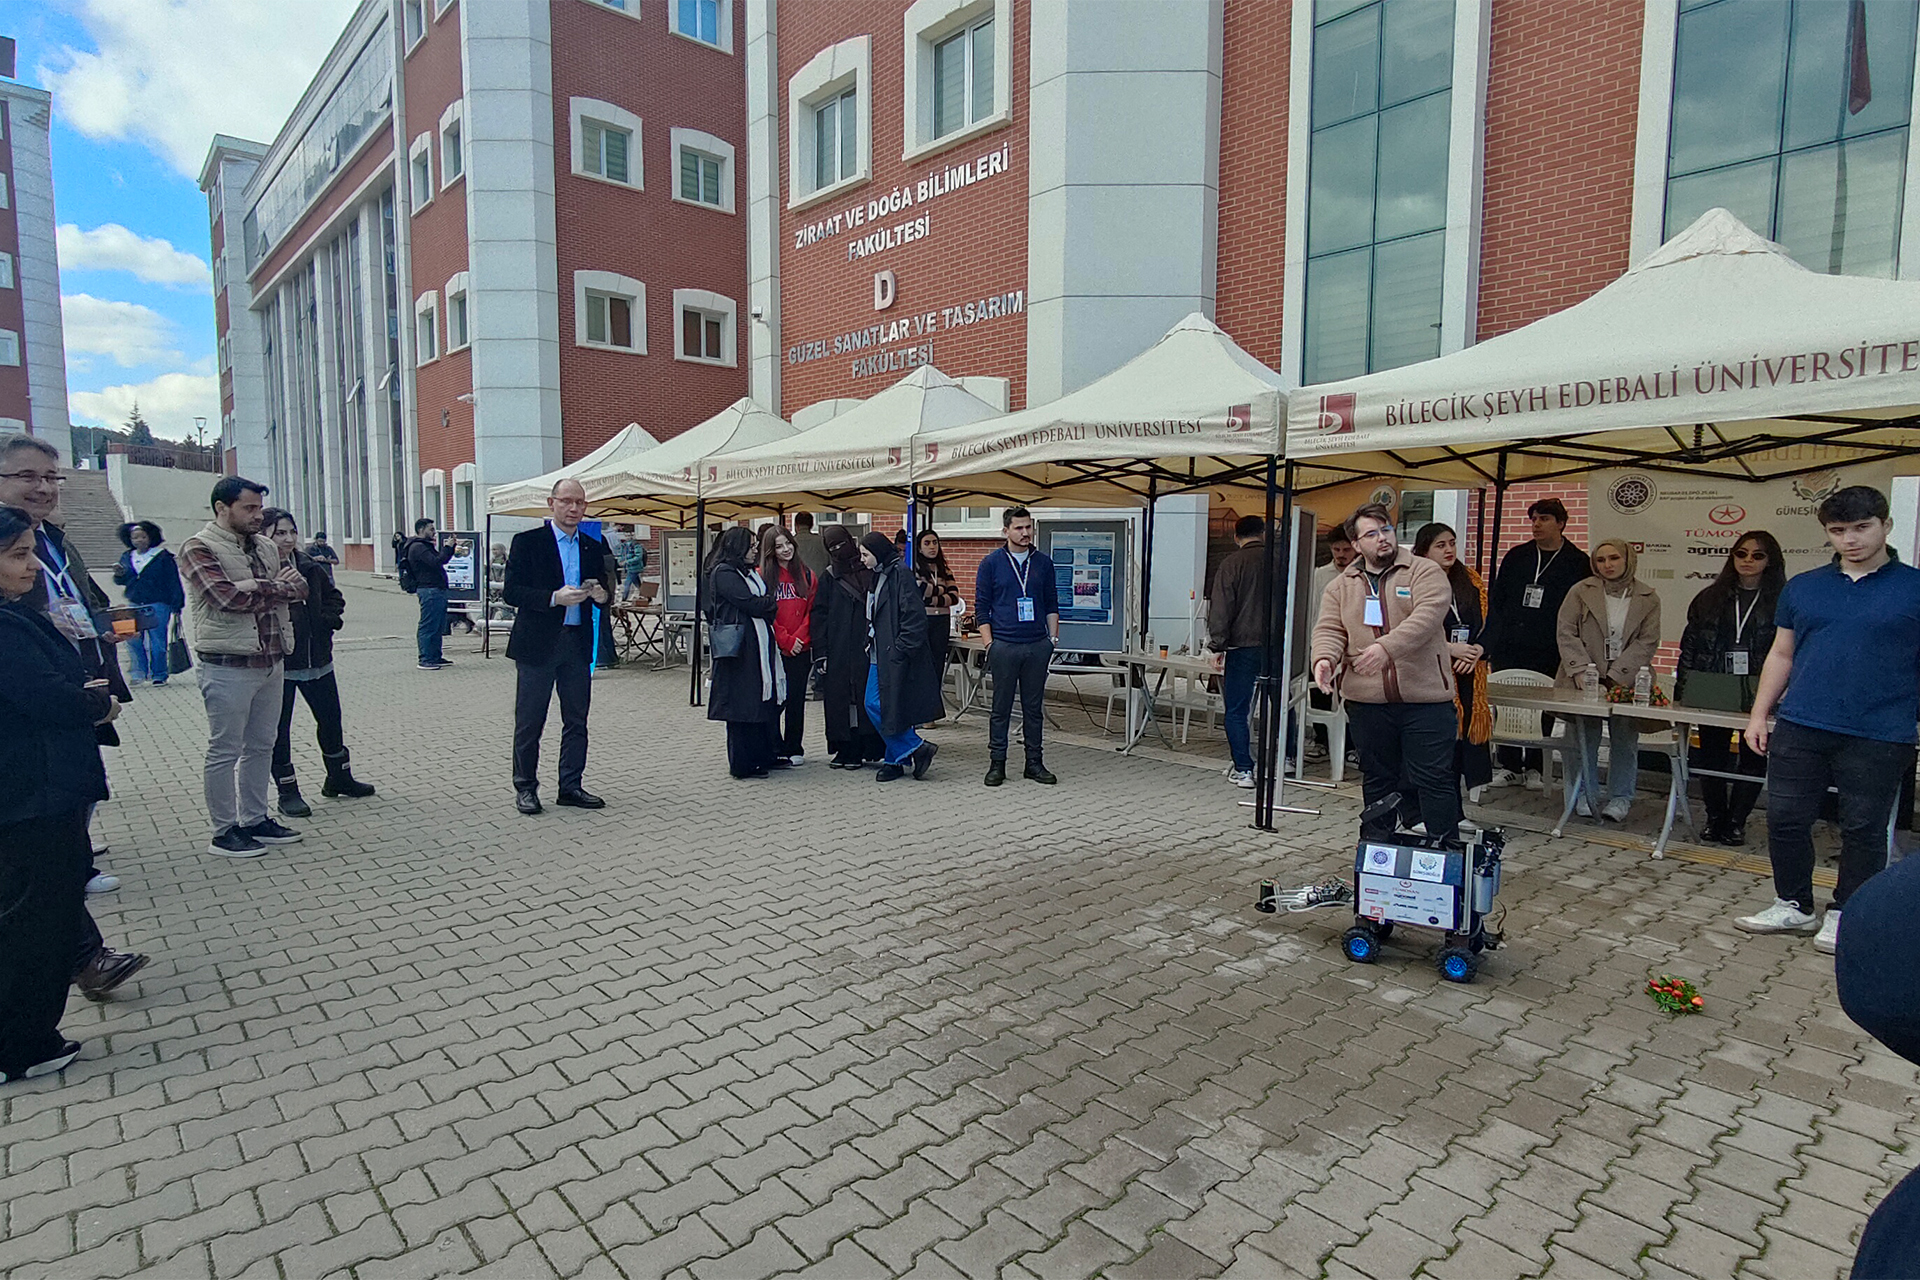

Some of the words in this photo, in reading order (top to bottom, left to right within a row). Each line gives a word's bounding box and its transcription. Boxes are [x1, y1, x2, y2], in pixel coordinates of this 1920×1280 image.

[795, 214, 842, 250] ZİRAAT
[845, 205, 864, 229] VE
[868, 186, 913, 221] DOĞA
[917, 142, 1009, 203] BİLİMLERİ
[848, 210, 930, 262] FAKÜLTESİ
[874, 270, 896, 311] D
[788, 339, 830, 365] GÜZEL
[834, 318, 910, 355] SANATLAR
[914, 311, 937, 335] VE
[941, 290, 1024, 329] TASARIM
[852, 339, 934, 379] FAKÜLTESİ
[1385, 393, 1478, 427] BİLECİK
[1483, 386, 1549, 423] ŞEYH
[1558, 364, 1680, 409] EDEBALİ
[1692, 340, 1920, 394] ÜNİVERSİTE
[951, 439, 997, 460] BİLECİK
[997, 434, 1029, 454] ŞEYH
[1032, 423, 1086, 445] EDEBALİ
[1095, 416, 1202, 439] ÜNİVERSİTESİ
